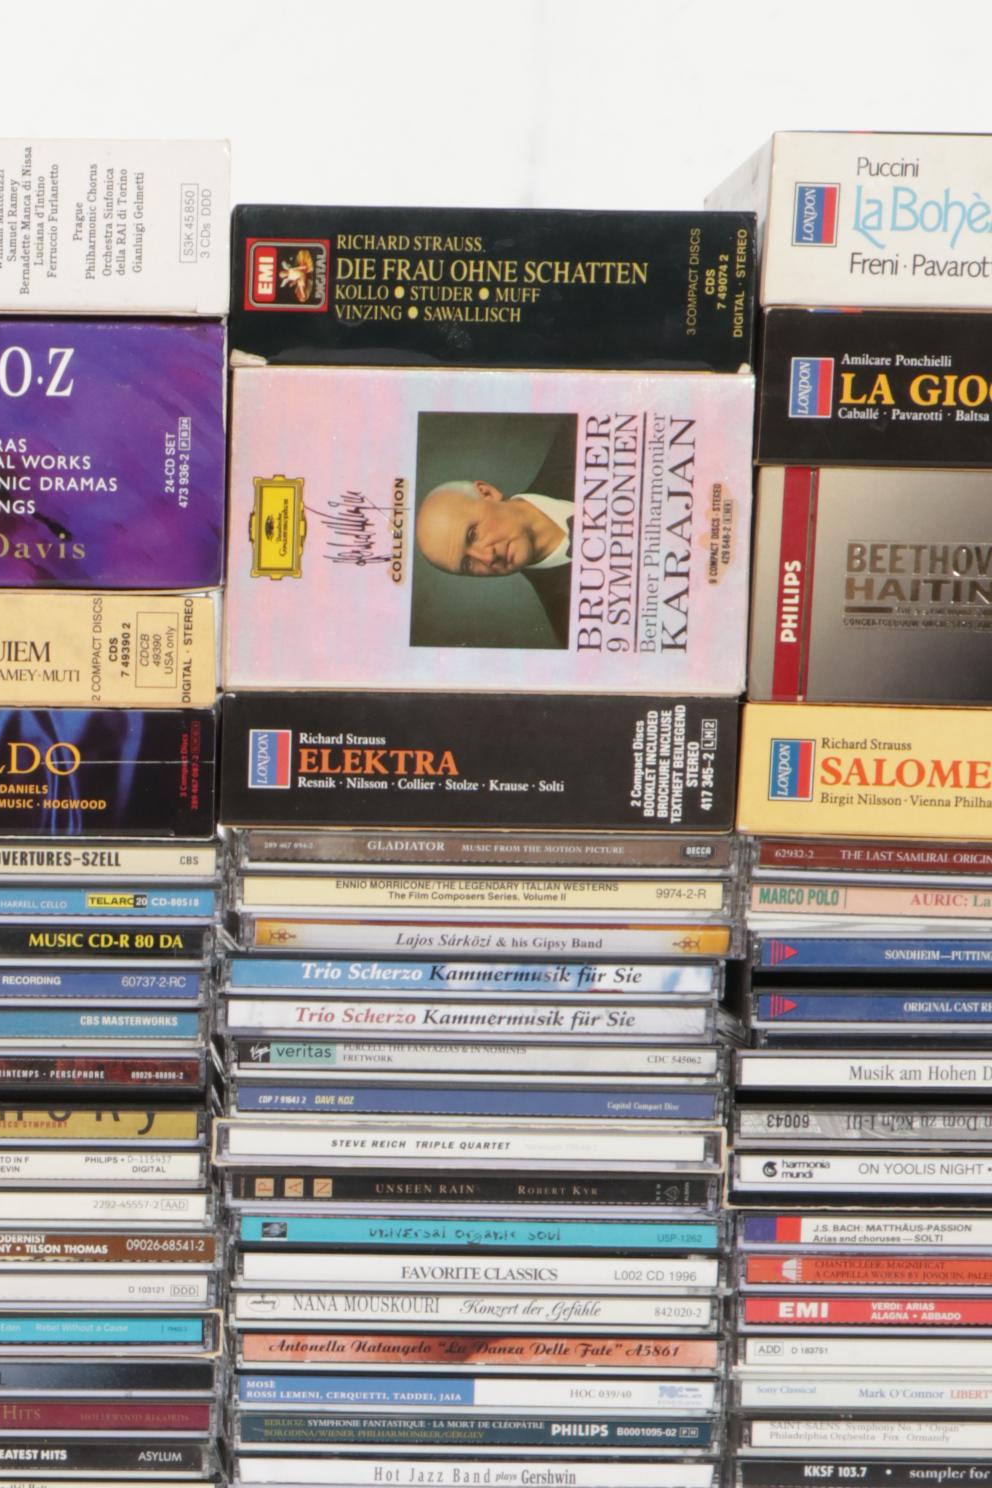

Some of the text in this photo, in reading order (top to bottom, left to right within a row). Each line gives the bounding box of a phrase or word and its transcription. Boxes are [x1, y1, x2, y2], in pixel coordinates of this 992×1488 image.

[857, 157, 919, 177] Puccini
[132, 172, 144, 273] Gianluigi Gelmetti
[803, 188, 816, 242] LONDON
[336, 258, 648, 285] DIE FRAU OHNE SCHATTEN
[850, 252, 899, 275] Freni
[841, 353, 952, 367] Amilcare Ponchielli
[840, 373, 894, 405] LA
[838, 407, 990, 422] Caballé Pavarotti Baltsa
[576, 414, 610, 653] BRUCKNER
[606, 412, 638, 653] 9 SYMPHONIEN
[661, 417, 696, 654] KARAJAN
[781, 559, 801, 643] PHILIPS
[821, 738, 912, 751] Richard Strauss
[298, 749, 459, 776] ELEKTRA
[820, 756, 992, 789] SALOME
[0, 784, 48, 795] DANIELS
[298, 777, 564, 793] Resnik Nilsson Collier Stolze Krause Solti
[367, 840, 445, 852] GLADIATOR
[760, 888, 839, 905] MARCO POLO
[29, 933, 183, 949] MUSIC CD-R 80 DA
[301, 963, 642, 985] Trio Scherzo Kammermusik für Sie
[276, 1044, 332, 1060] veritas
[849, 1065, 976, 1081] Musik am Hohen
[401, 1265, 558, 1282] FAVORITE CLASSICS
[779, 1302, 829, 1318] EMI
[551, 1423, 608, 1437] PHILIPS
[804, 1466, 867, 1477] KKSF 103.7
